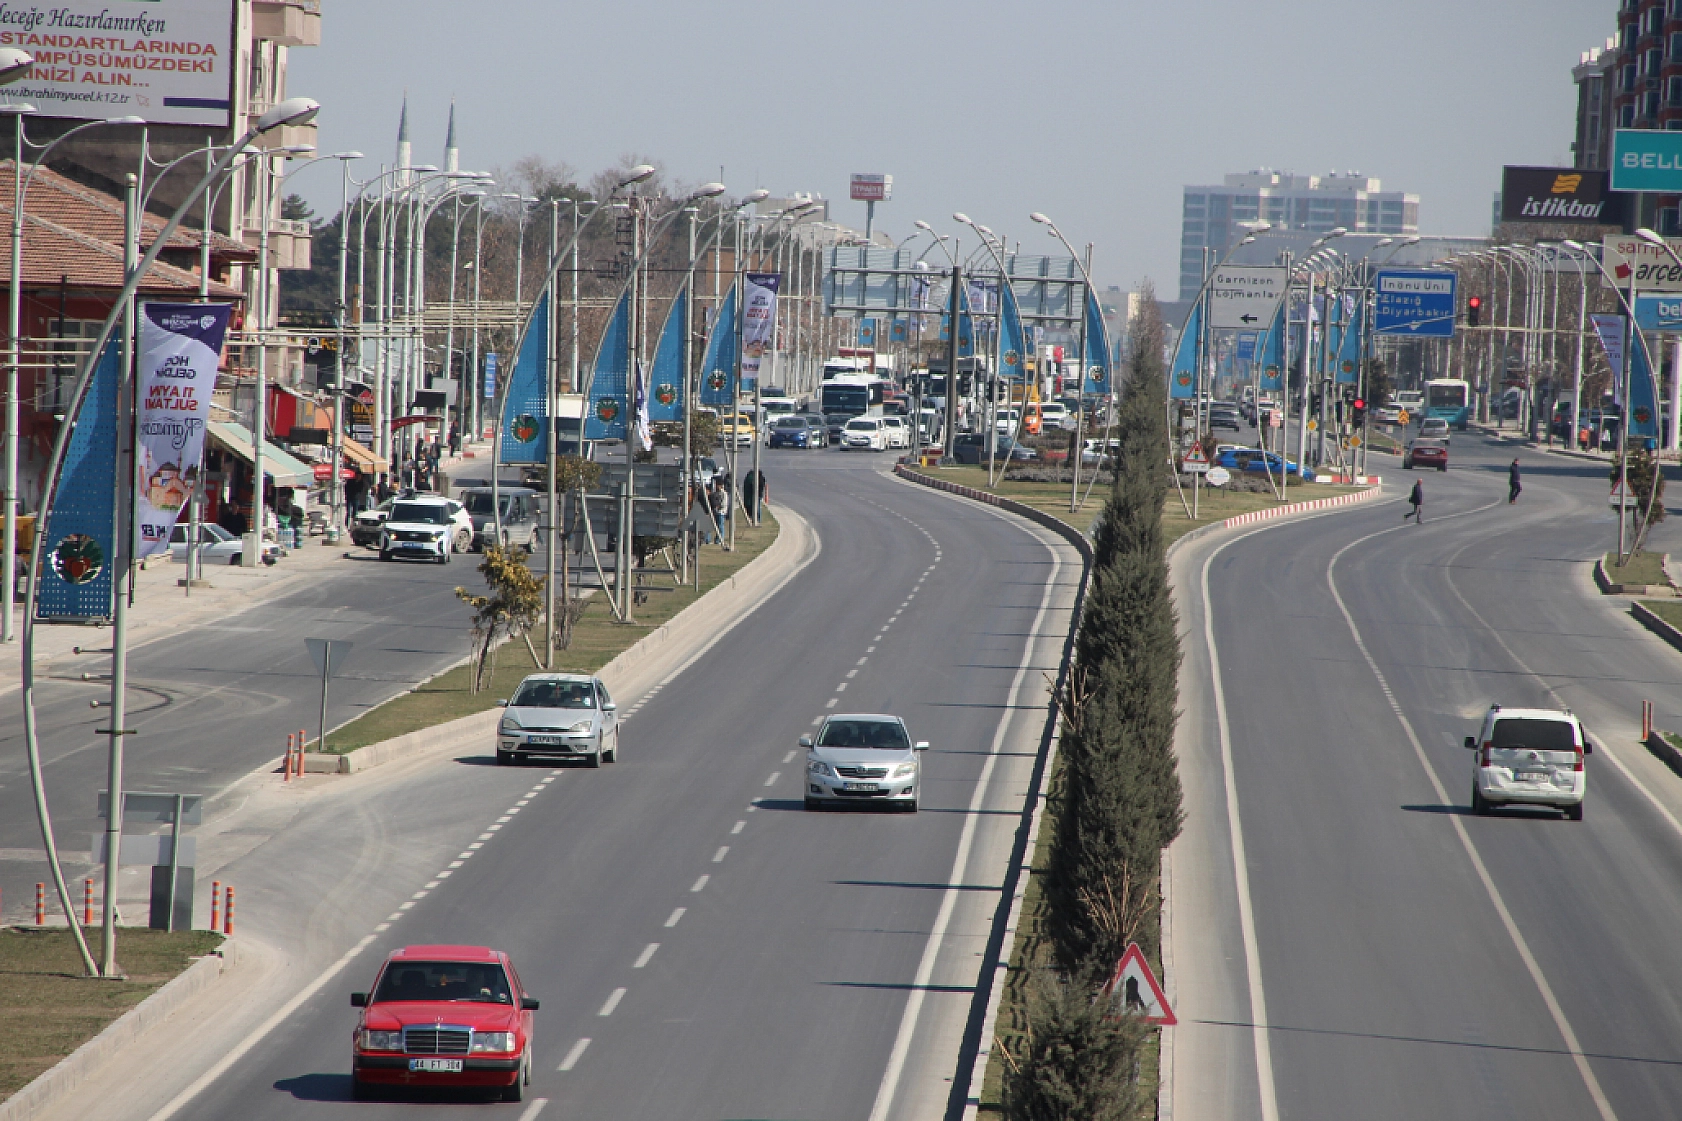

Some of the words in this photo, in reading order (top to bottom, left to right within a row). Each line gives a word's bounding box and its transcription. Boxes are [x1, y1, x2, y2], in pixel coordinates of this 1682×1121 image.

[47, 7, 165, 36] Hazırlanırken
[0, 31, 217, 56] STANDARTLARINDA
[23, 50, 213, 73] MPÜSÜMÜZDEKİ
[81, 71, 150, 87] ALIN...
[1622, 152, 1682, 170] BELL
[1521, 196, 1605, 218] istikbal
[1217, 274, 1274, 285] Garnizon
